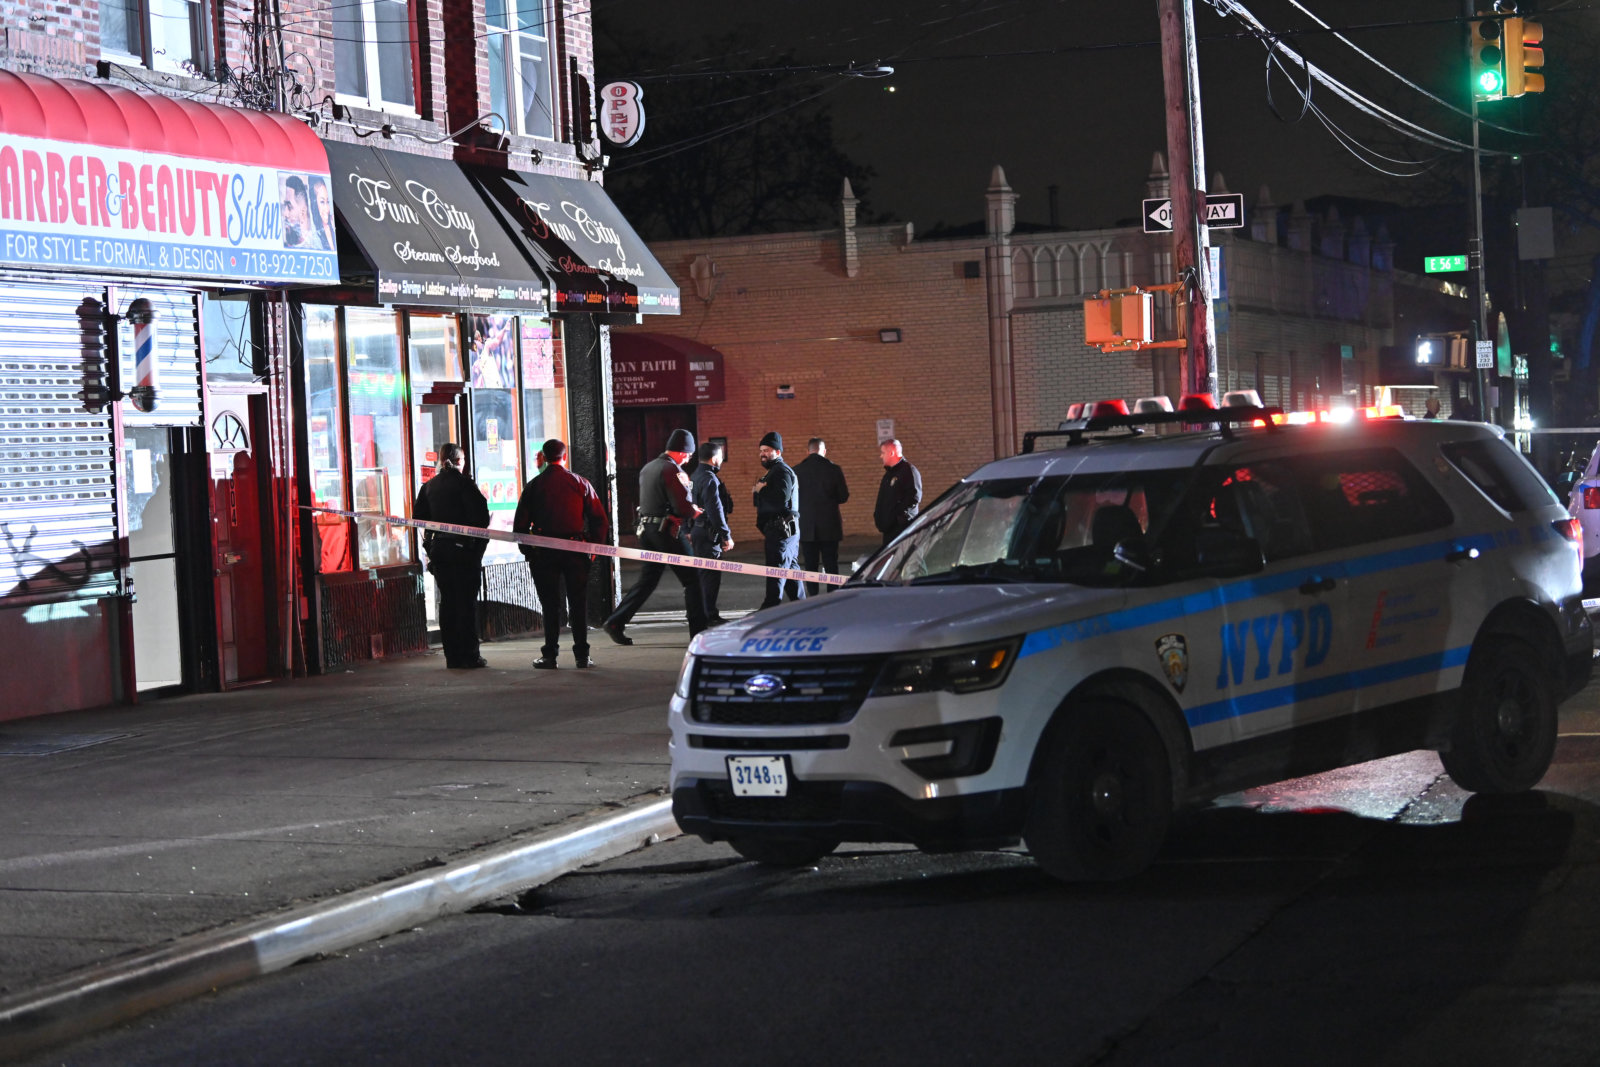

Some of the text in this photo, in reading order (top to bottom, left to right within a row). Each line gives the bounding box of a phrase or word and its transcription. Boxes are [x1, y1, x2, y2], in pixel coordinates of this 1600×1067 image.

[610, 86, 628, 139] OPEN
[106, 173, 127, 217] &
[118, 161, 230, 239] BEAUTY
[228, 173, 282, 246] Salon
[349, 173, 480, 249] Fun City
[516, 197, 626, 262] Fun City
[6, 234, 333, 277] FOR STYLE FORMAL & DESIGN 718-922-7250
[394, 241, 500, 271] Steam Seafood
[558, 255, 644, 279] Steam Seafood
[1430, 258, 1437, 270] E
[1440, 258, 1451, 270] 56
[641, 360, 676, 371] FAITH
[740, 636, 829, 653] POLICE
[1216, 603, 1333, 690] NYPD
[735, 765, 783, 784] 3748 17
